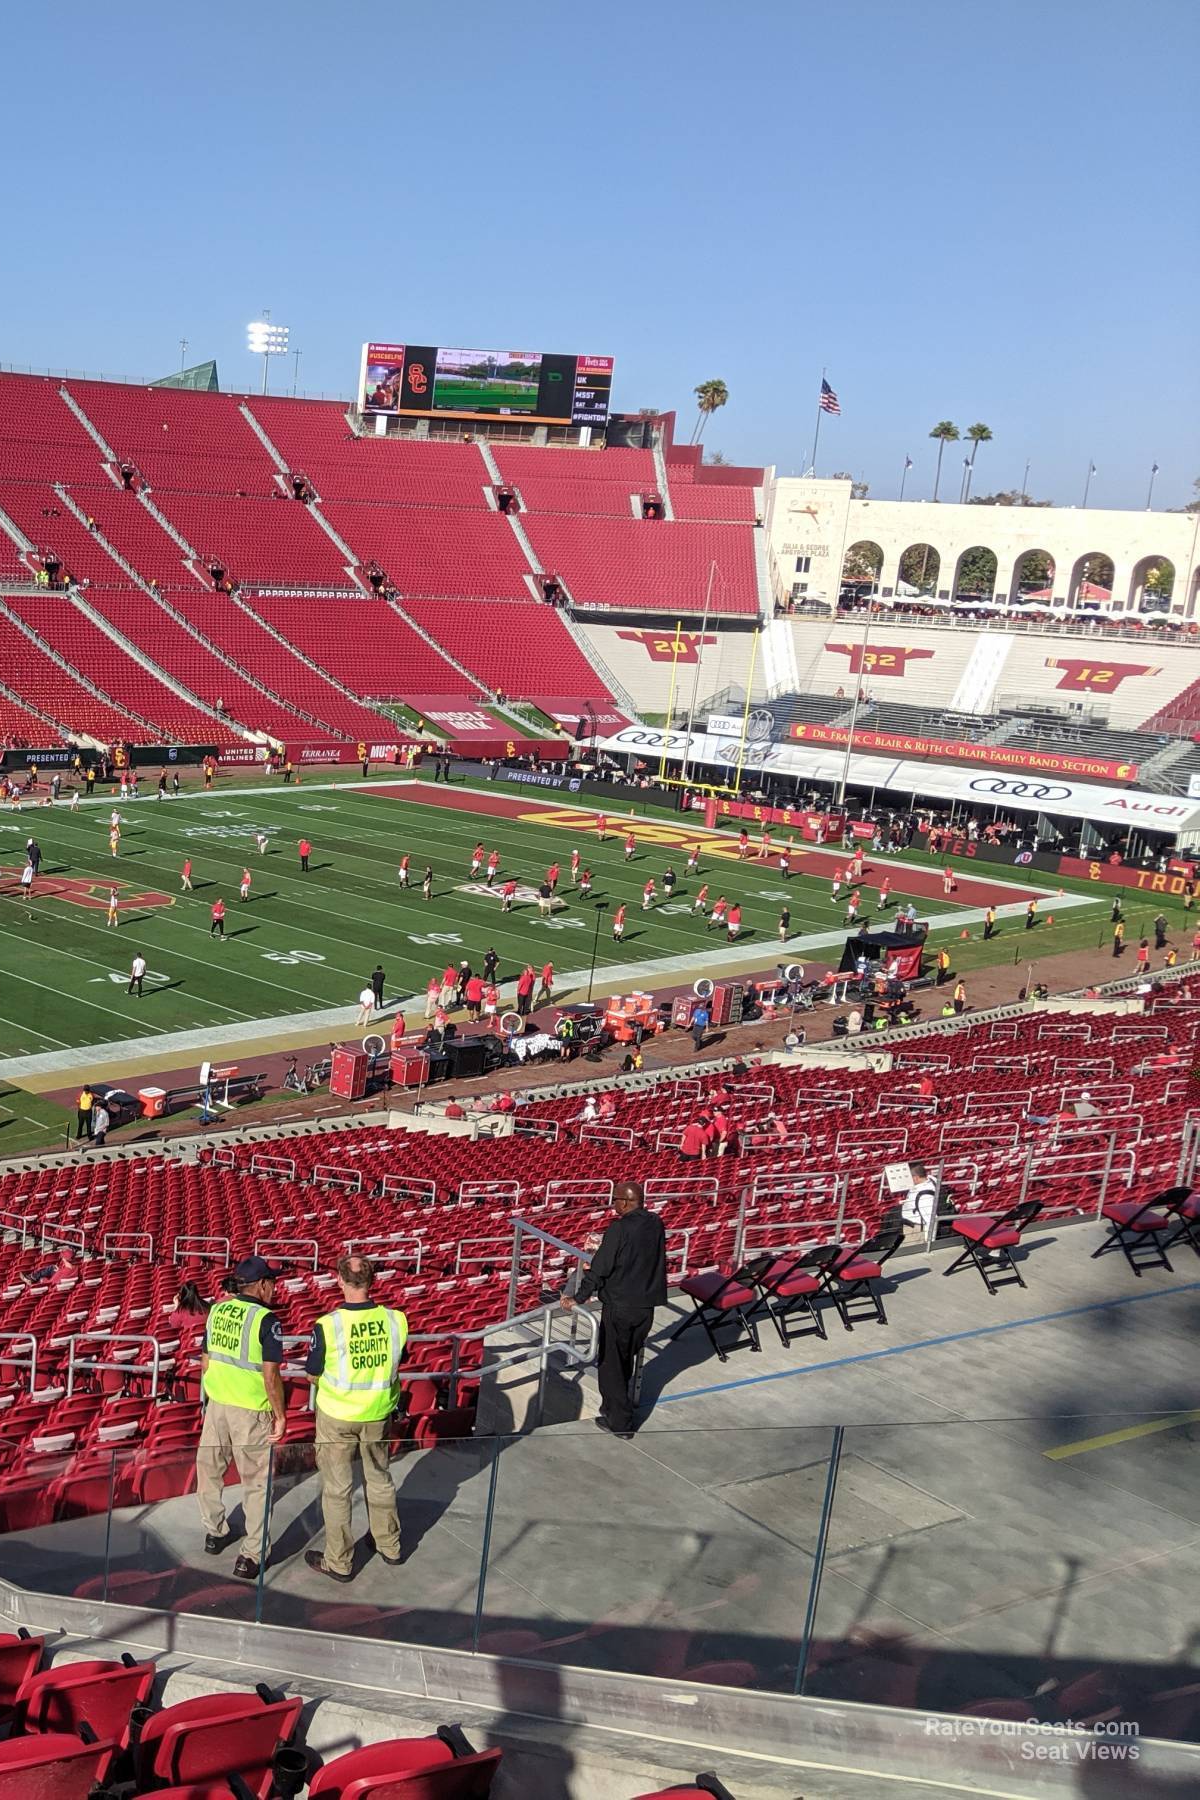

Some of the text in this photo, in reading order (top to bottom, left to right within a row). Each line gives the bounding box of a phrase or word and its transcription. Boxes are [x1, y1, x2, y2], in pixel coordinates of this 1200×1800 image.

[653, 640, 689, 654] 20
[863, 653, 897, 667] 32
[1075, 668, 1115, 683] 12
[424, 711, 492, 721] MUSCLE
[448, 720, 496, 730] MILK
[904, 740, 912, 749] &
[26, 753, 69, 762] PRESENTED
[218, 754, 254, 762] AIRLINES
[225, 748, 254, 756] UNITED
[301, 749, 341, 757] TERRANEA
[508, 772, 563, 787] PRESENTED BY
[1103, 798, 1192, 817] Audi
[407, 933, 464, 946] 40
[261, 950, 327, 965] 50
[216, 1302, 247, 1320] APEX
[212, 1315, 242, 1337] SECURITY
[350, 1320, 386, 1339] APEX
[211, 1332, 240, 1352] GROUP
[349, 1337, 389, 1354] SECURITY
[351, 1353, 388, 1370] GROUP
